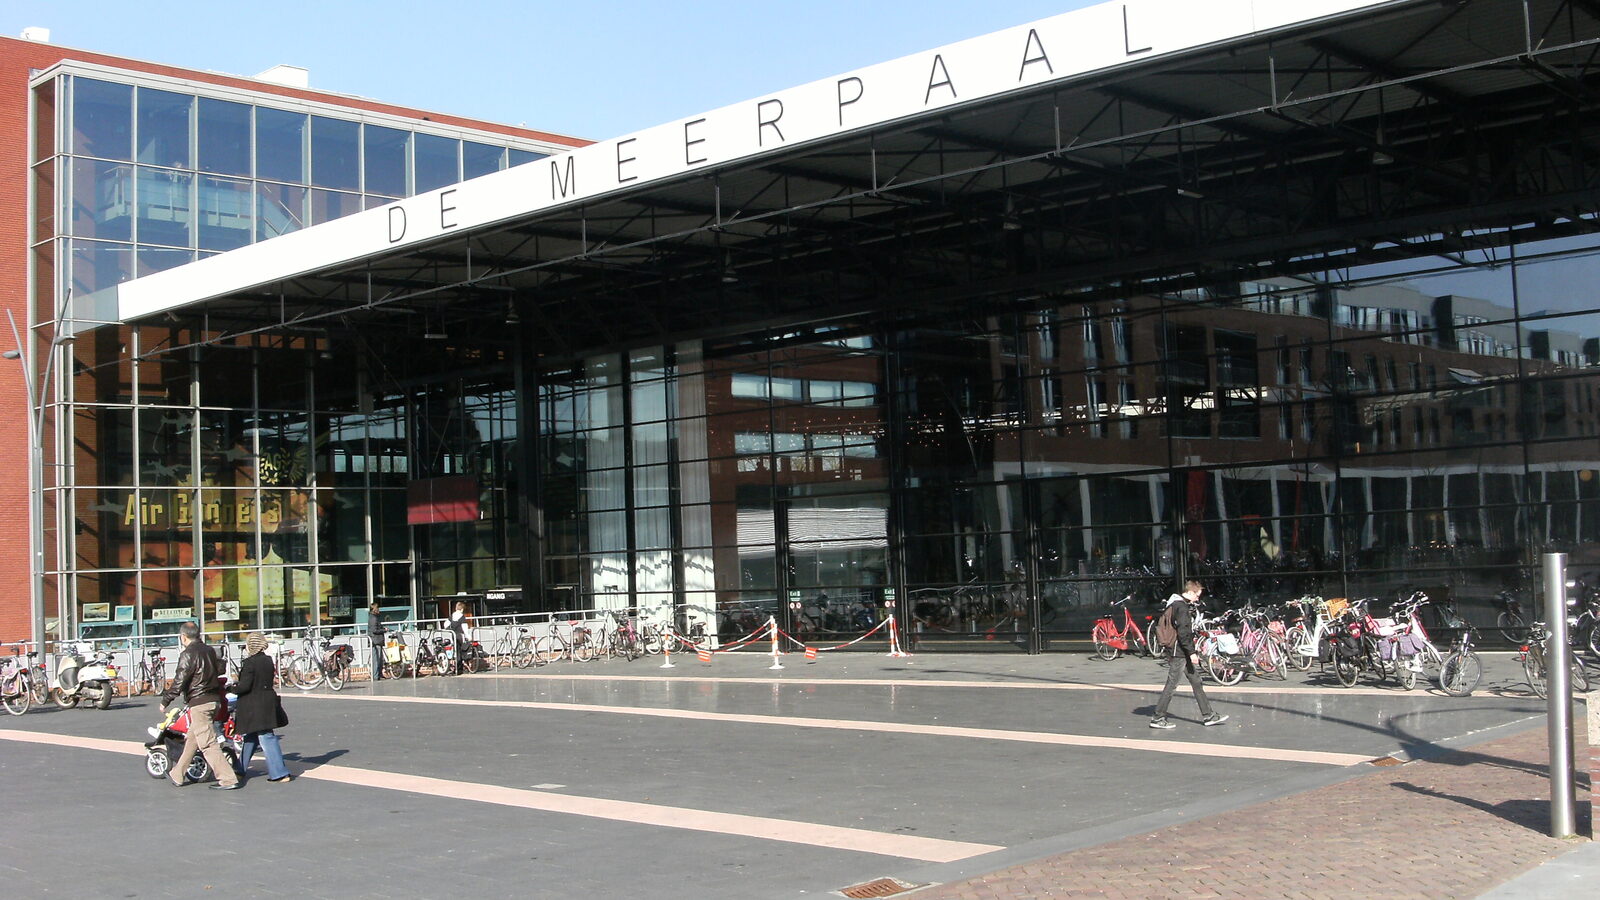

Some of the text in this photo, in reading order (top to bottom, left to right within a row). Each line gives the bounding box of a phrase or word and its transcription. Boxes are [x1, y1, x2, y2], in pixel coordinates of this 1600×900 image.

[388, 4, 1153, 243] DE MEERPAAL
[124, 493, 279, 525] Air Gnnes
